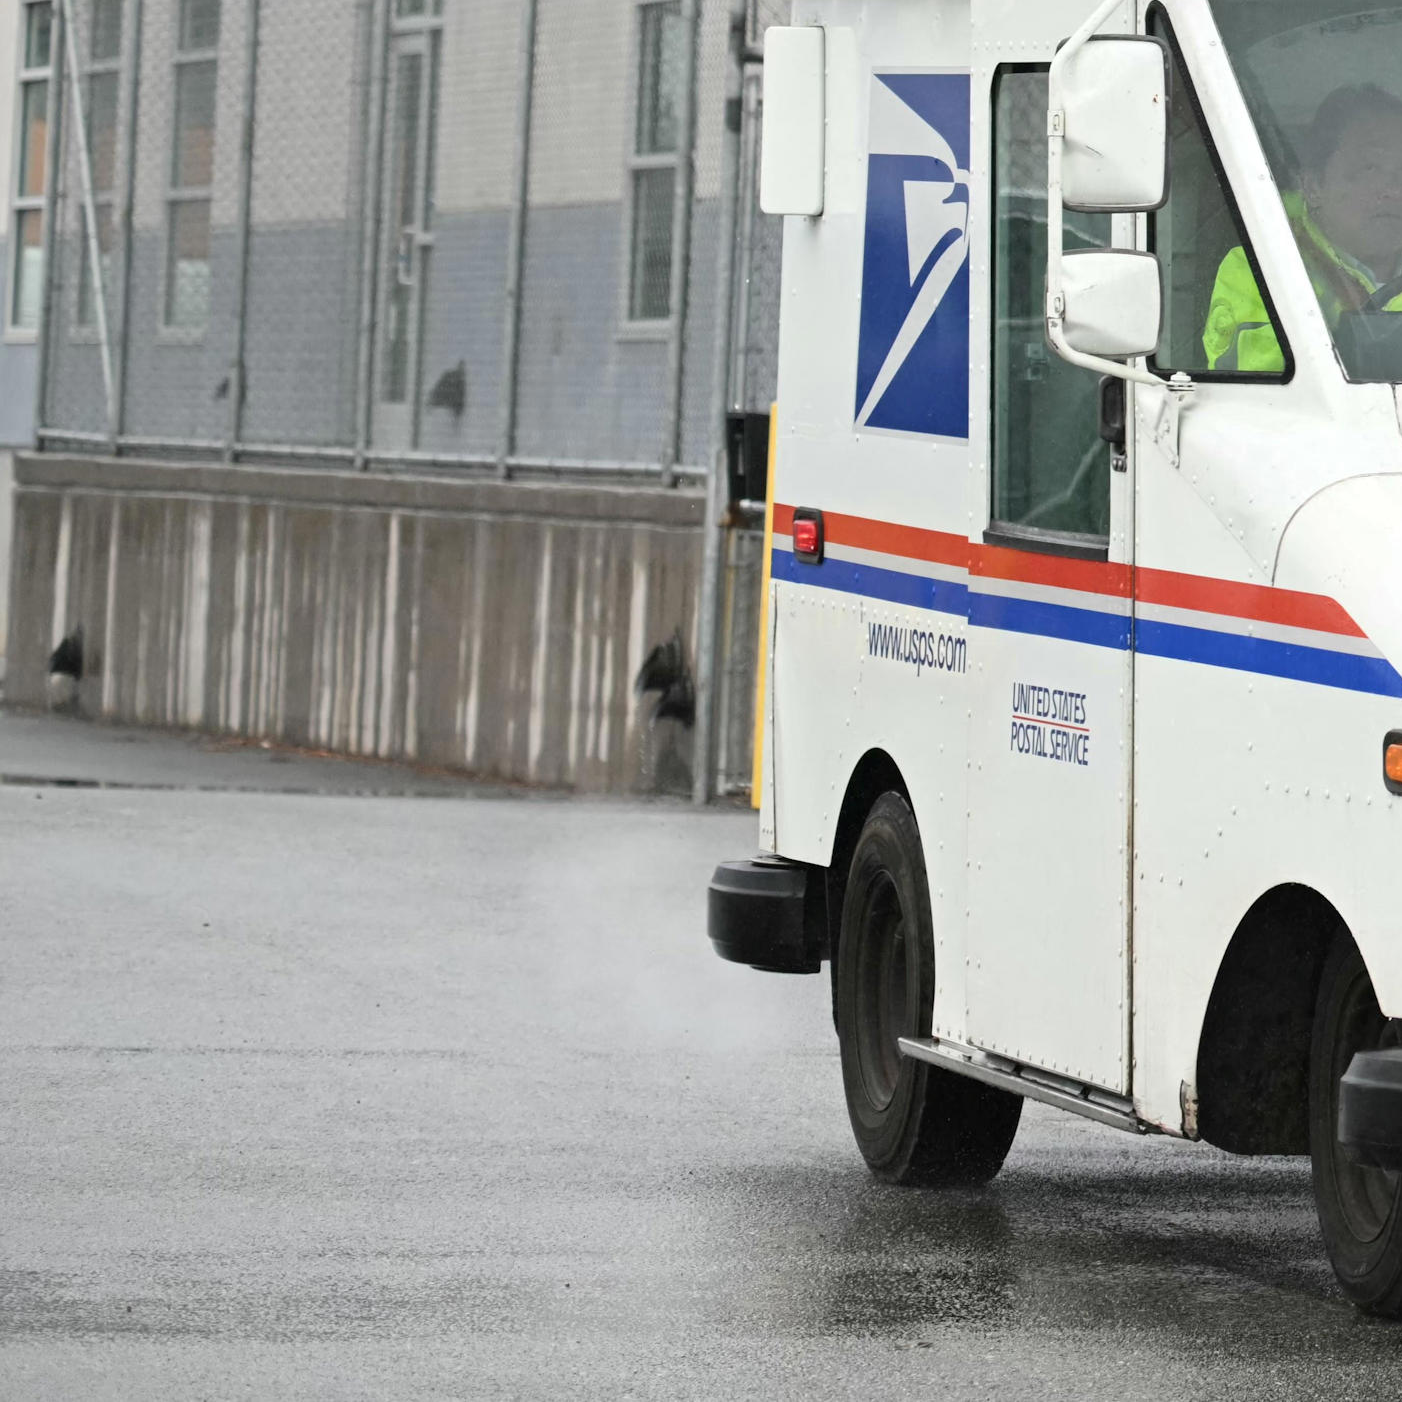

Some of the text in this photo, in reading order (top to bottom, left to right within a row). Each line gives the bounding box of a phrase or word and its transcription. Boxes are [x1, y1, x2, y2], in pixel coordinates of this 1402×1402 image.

[867, 621, 967, 678] www.usps.com
[1012, 681, 1087, 725] UNITED STATES
[1010, 721, 1090, 766] POSTAL SERVICE
